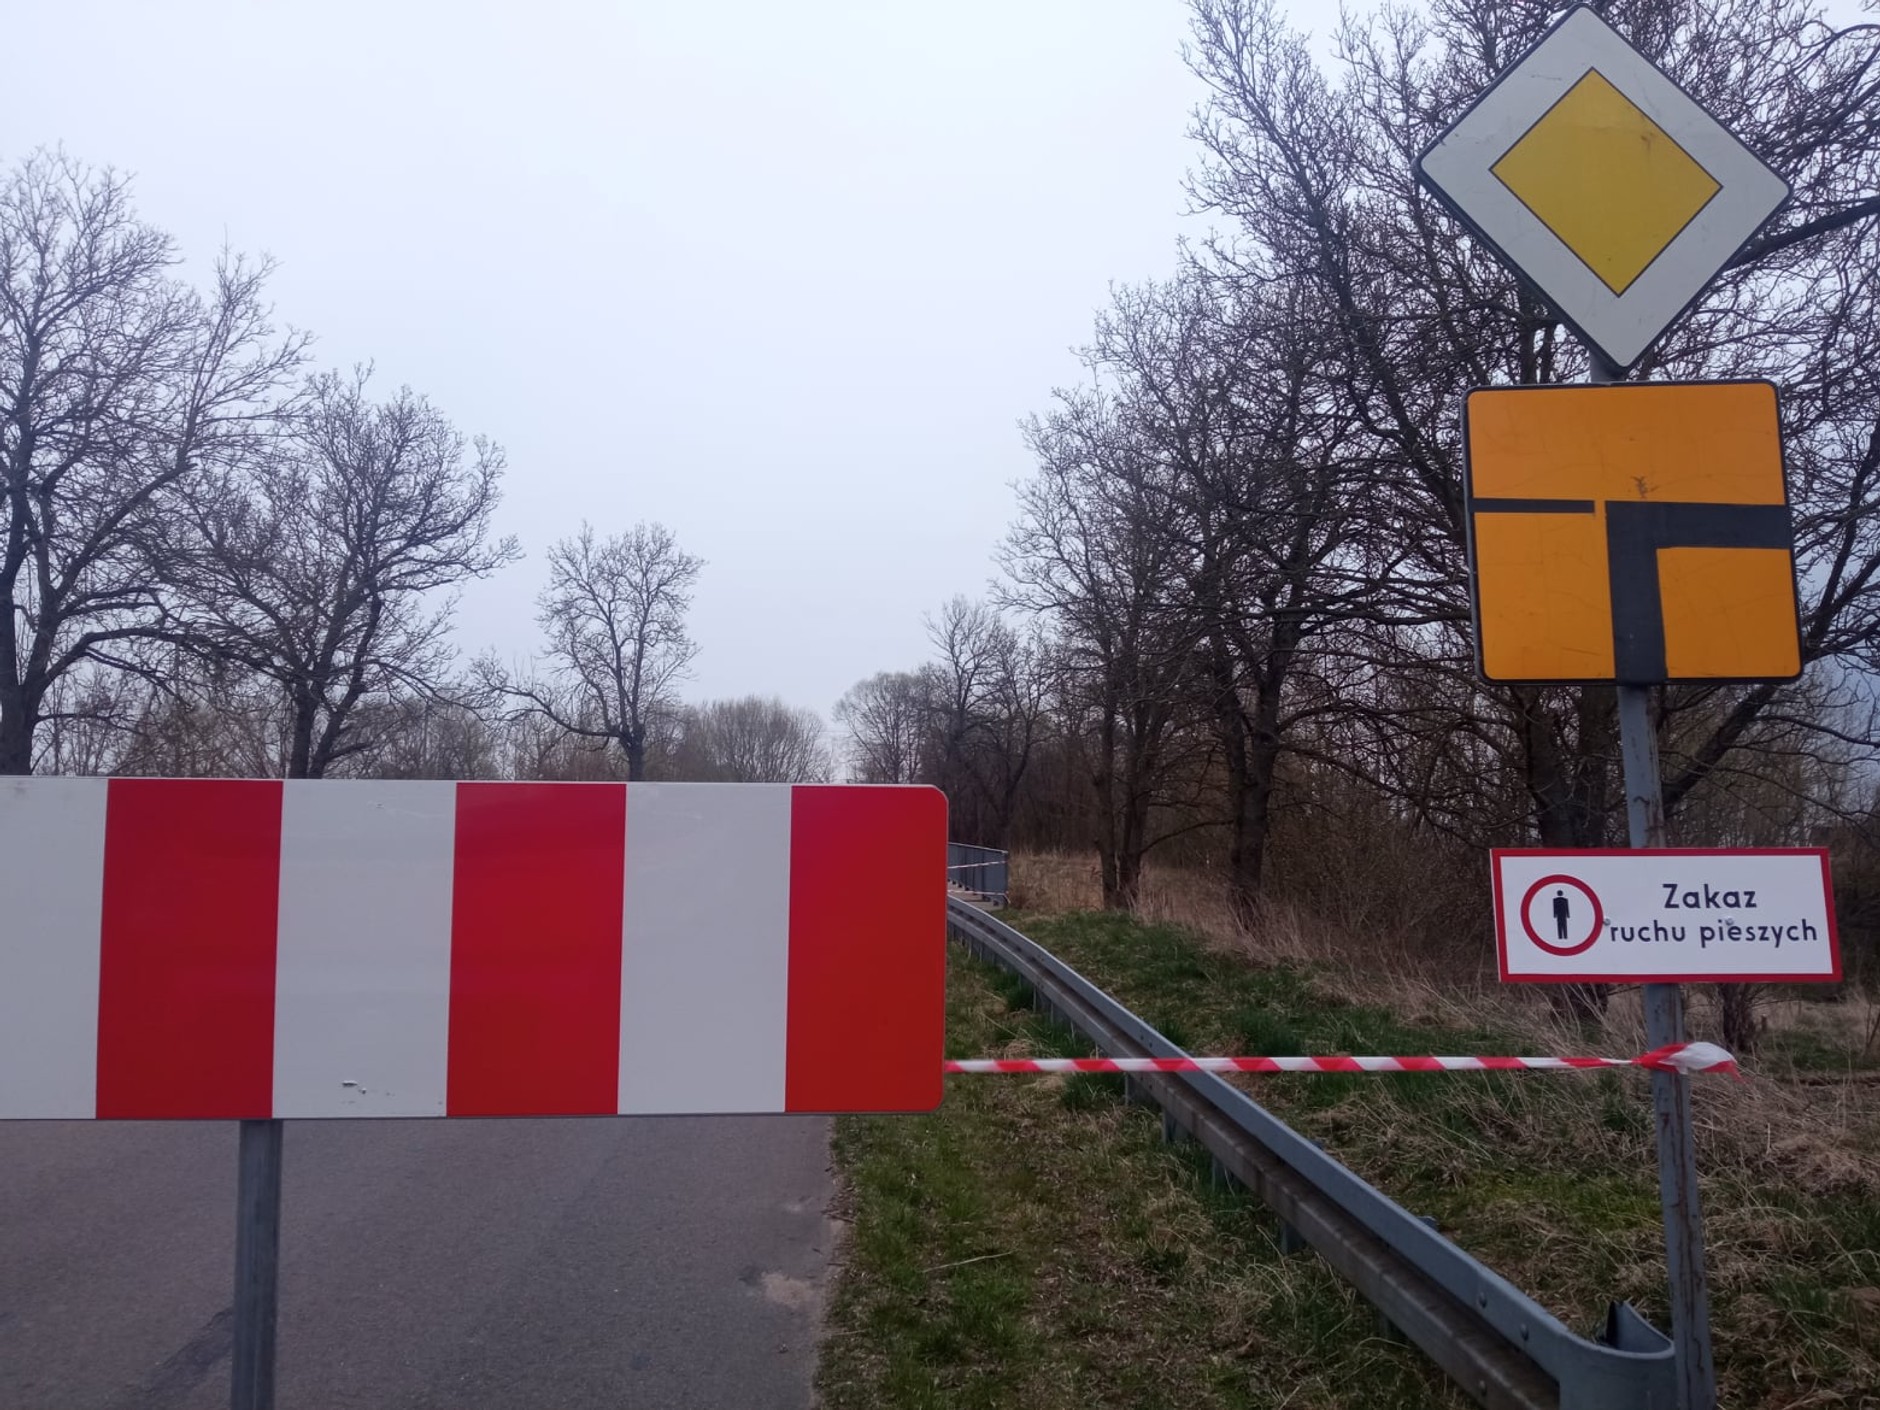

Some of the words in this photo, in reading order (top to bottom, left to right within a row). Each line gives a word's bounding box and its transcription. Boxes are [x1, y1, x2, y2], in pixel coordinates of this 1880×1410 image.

[1662, 883, 1758, 909] Zakaz
[1610, 919, 1686, 942] ruchu
[1700, 918, 1818, 948] pieszych
